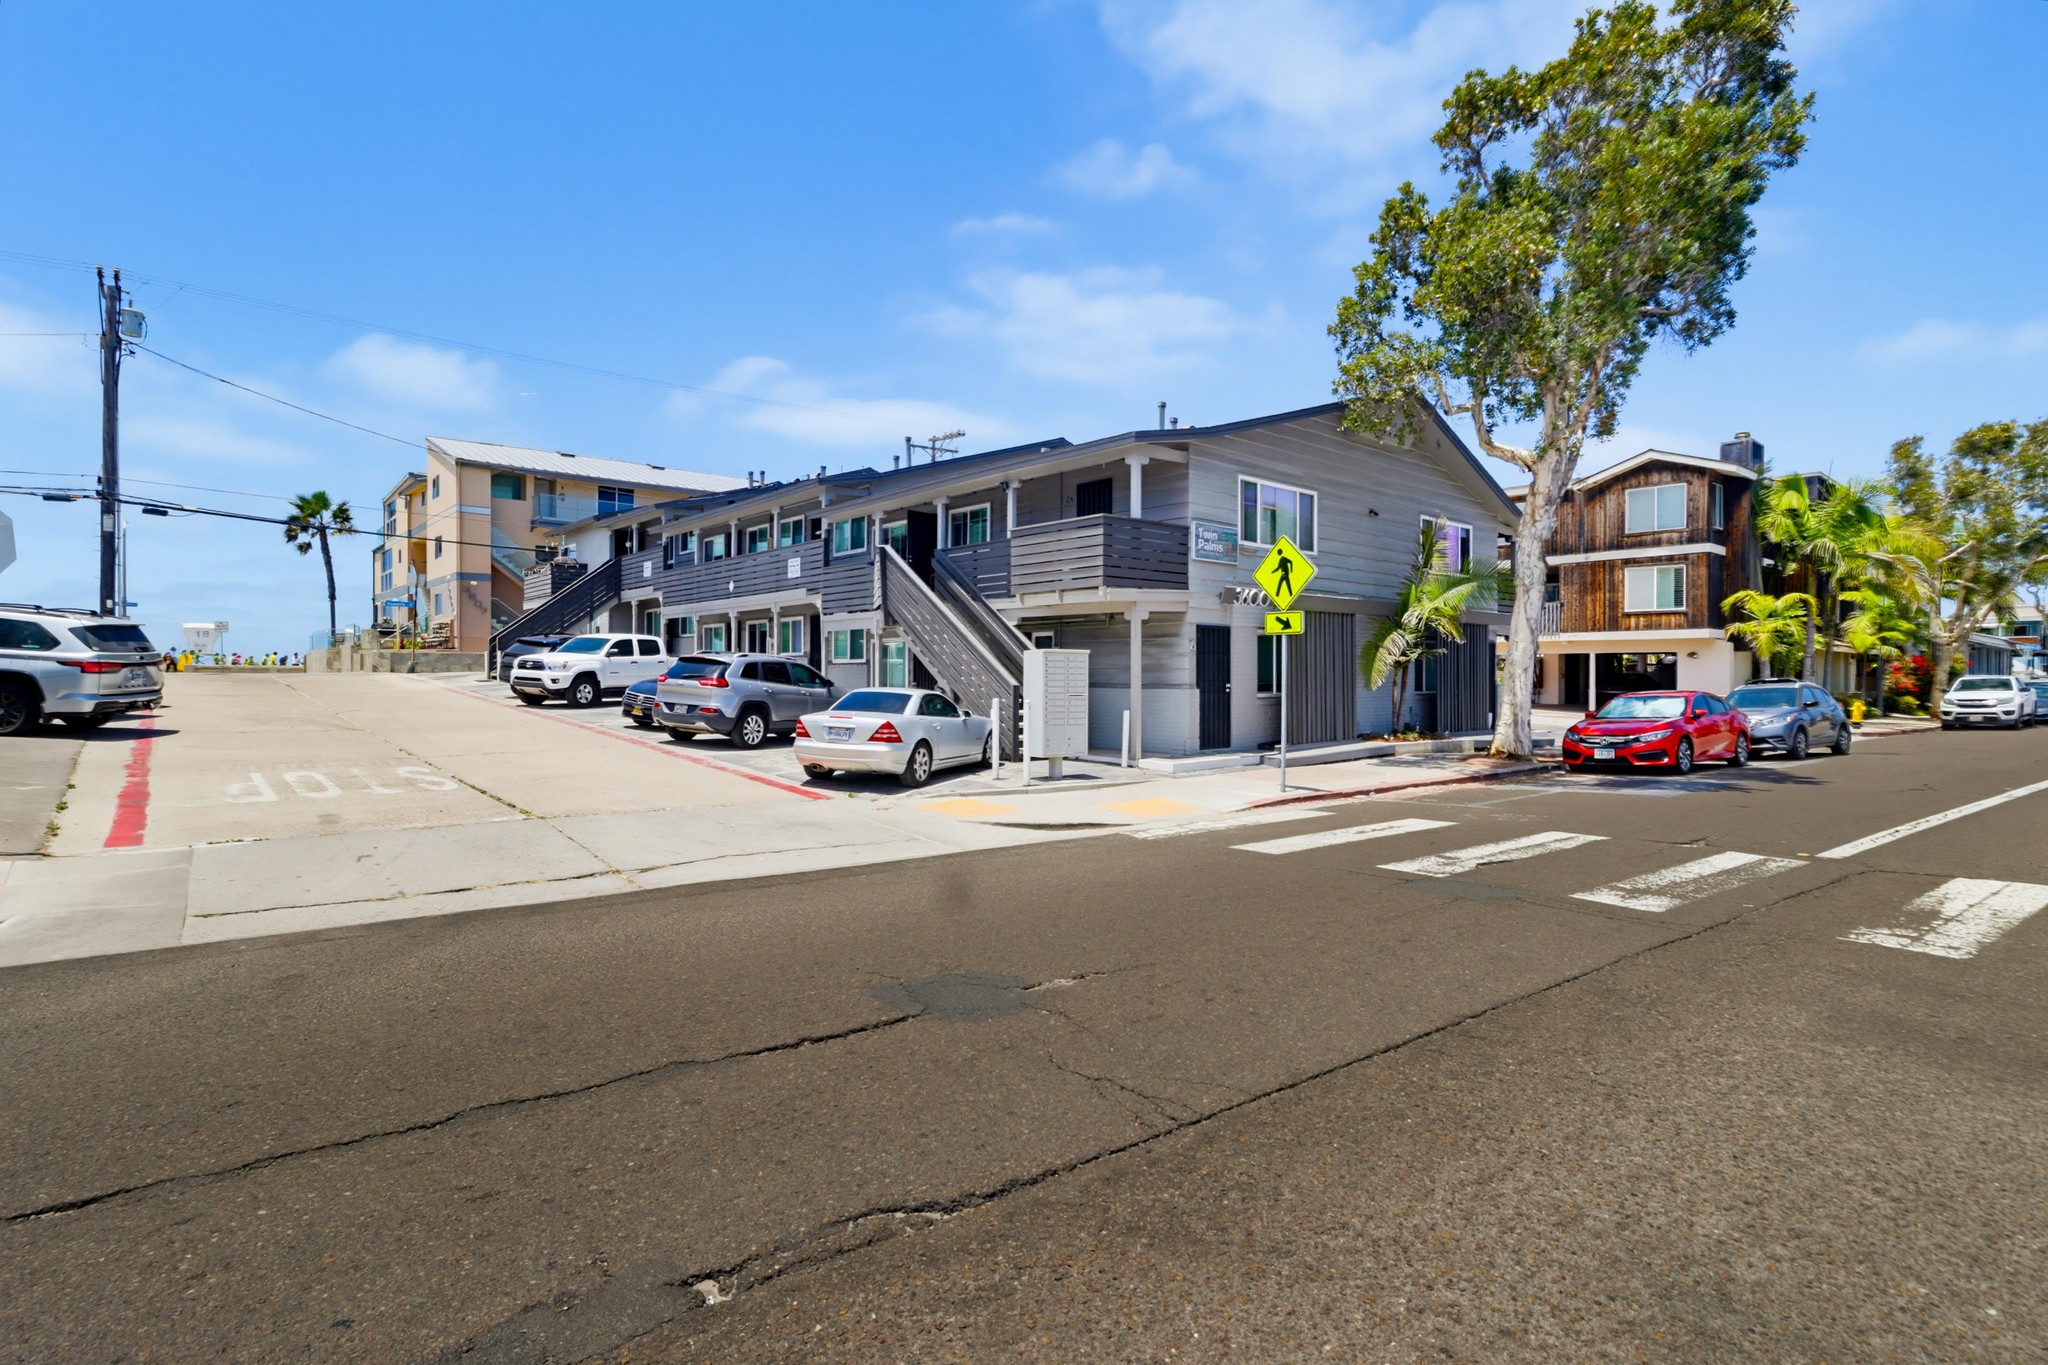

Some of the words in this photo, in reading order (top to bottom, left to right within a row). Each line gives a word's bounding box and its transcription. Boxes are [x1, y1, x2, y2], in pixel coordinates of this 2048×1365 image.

[1198, 527, 1218, 540] Twin
[1198, 539, 1223, 553] Palms
[225, 766, 459, 803] STOP
